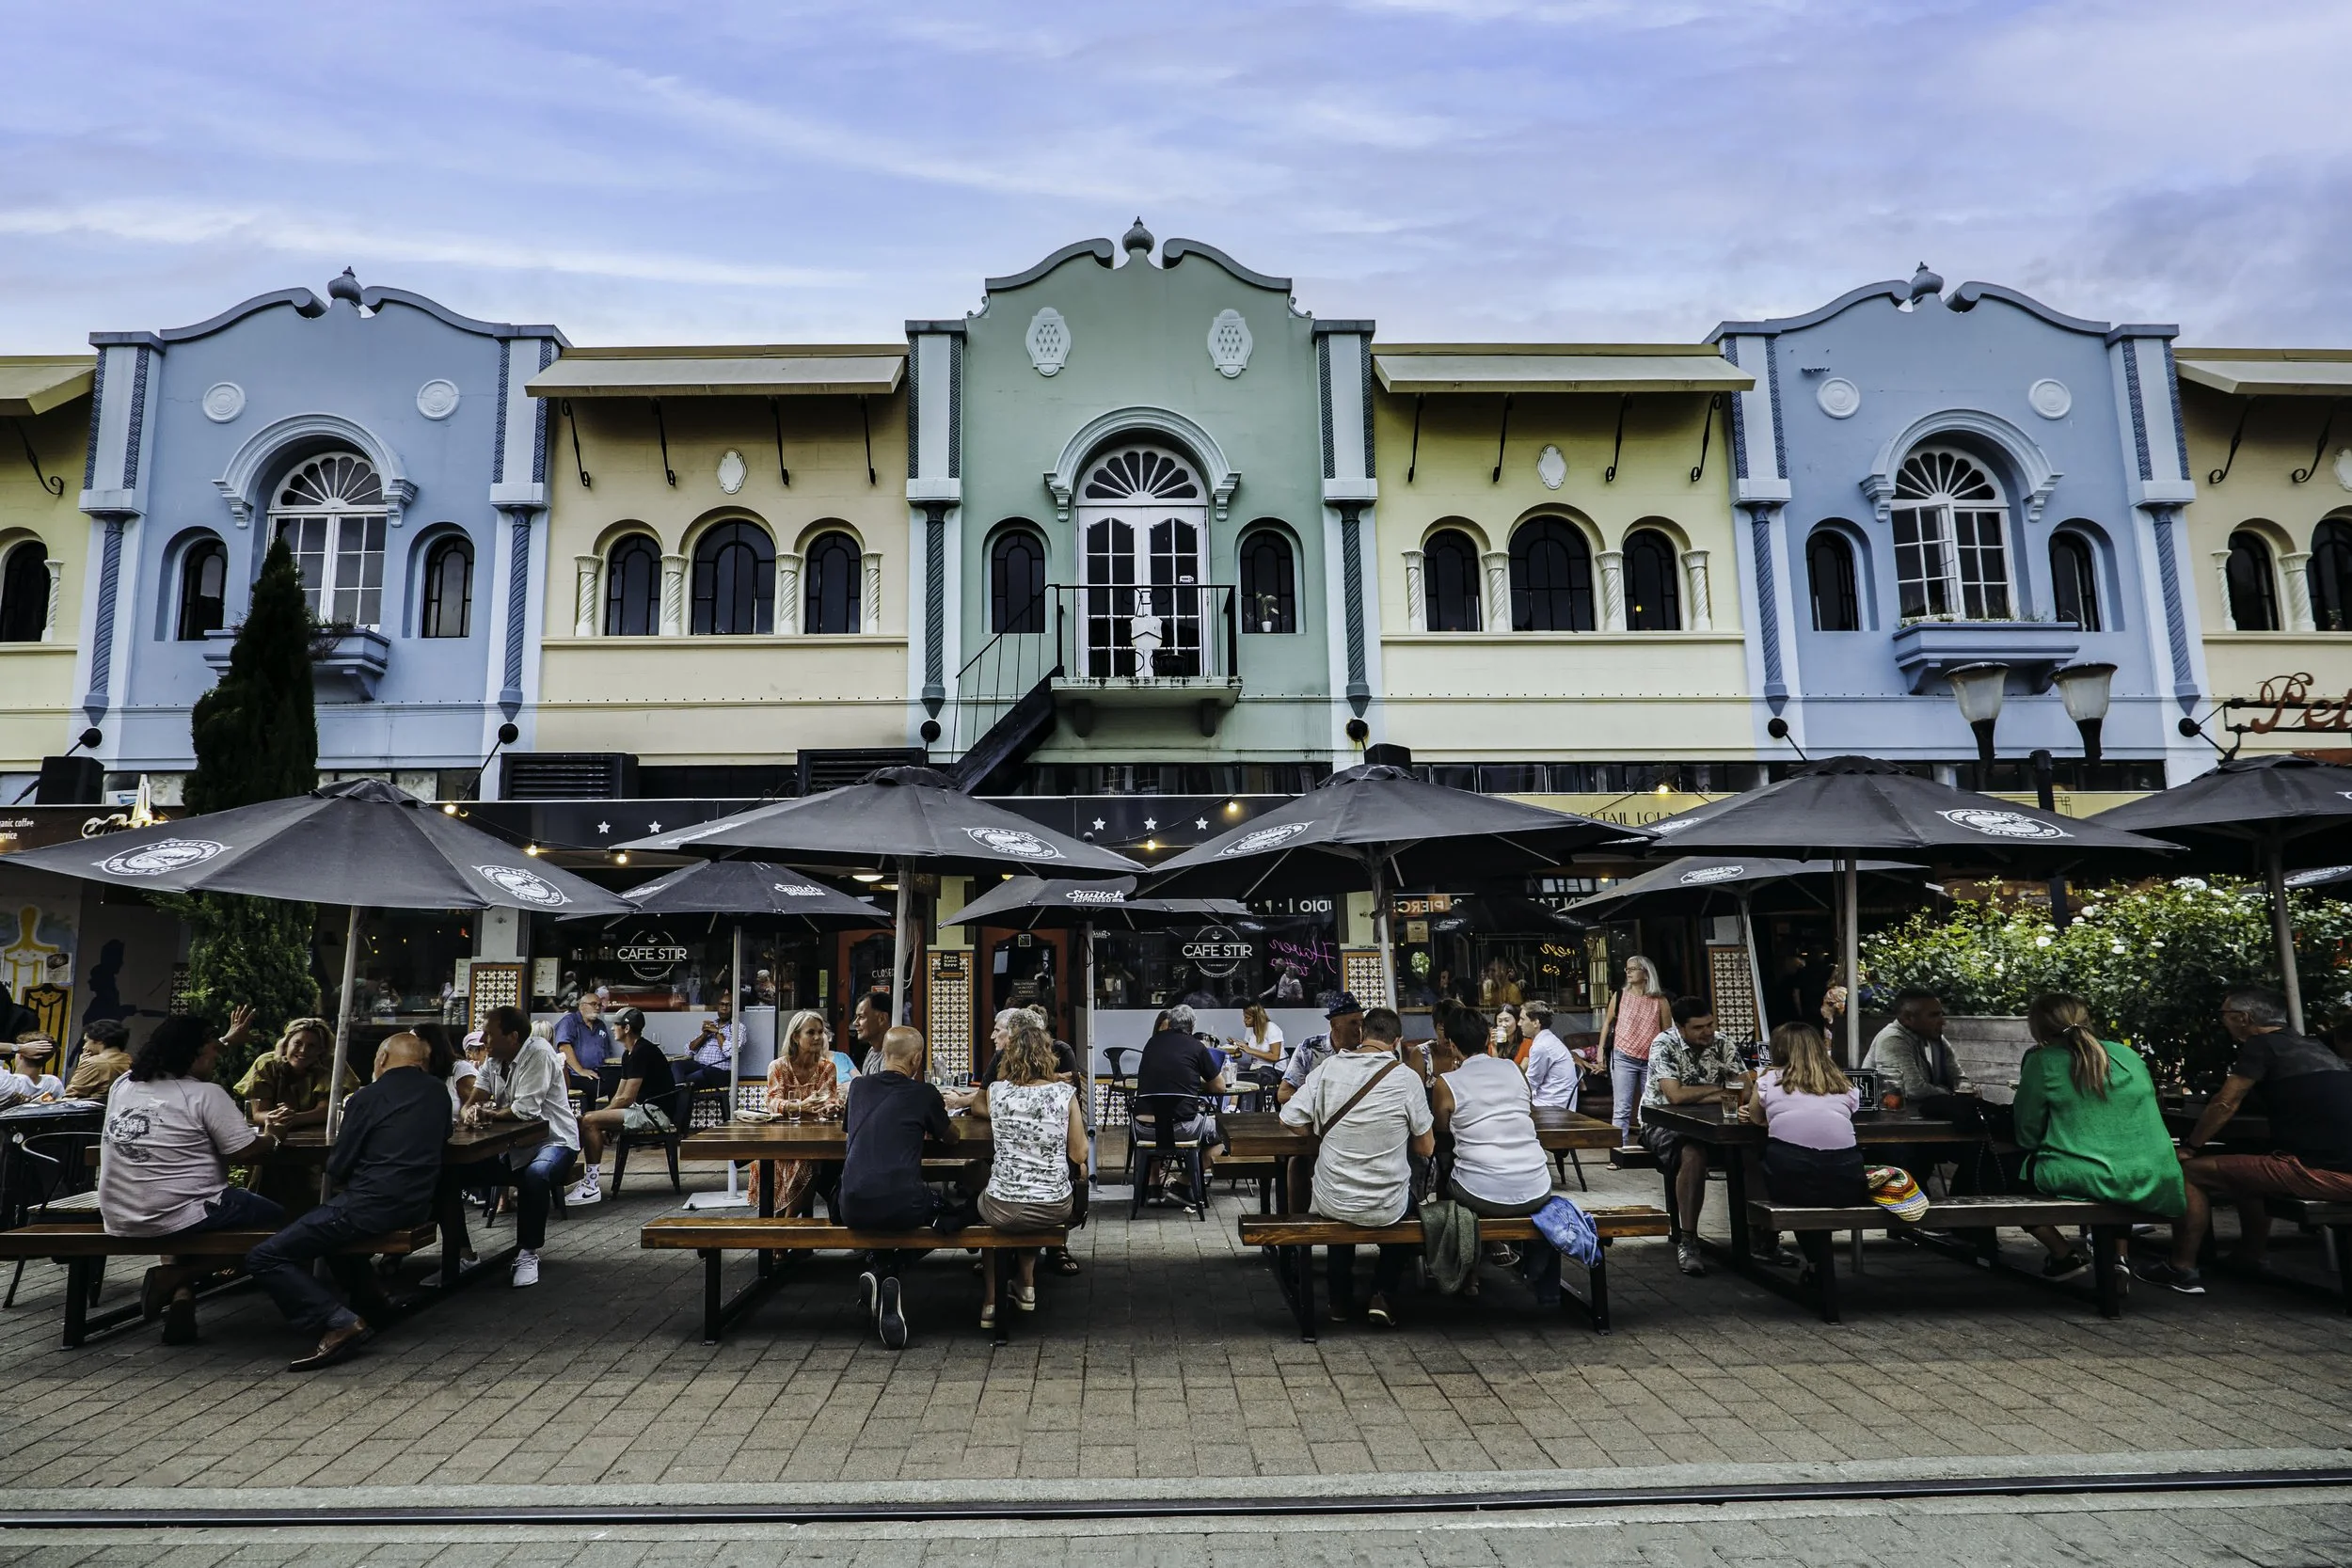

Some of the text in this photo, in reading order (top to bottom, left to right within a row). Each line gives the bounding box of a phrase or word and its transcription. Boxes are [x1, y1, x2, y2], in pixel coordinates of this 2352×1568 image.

[15, 817, 35, 828] coffee
[1066, 890, 1124, 900] Switch
[617, 948, 687, 959] CAFE STIR
[1182, 944, 1252, 957] CAFE STIR
